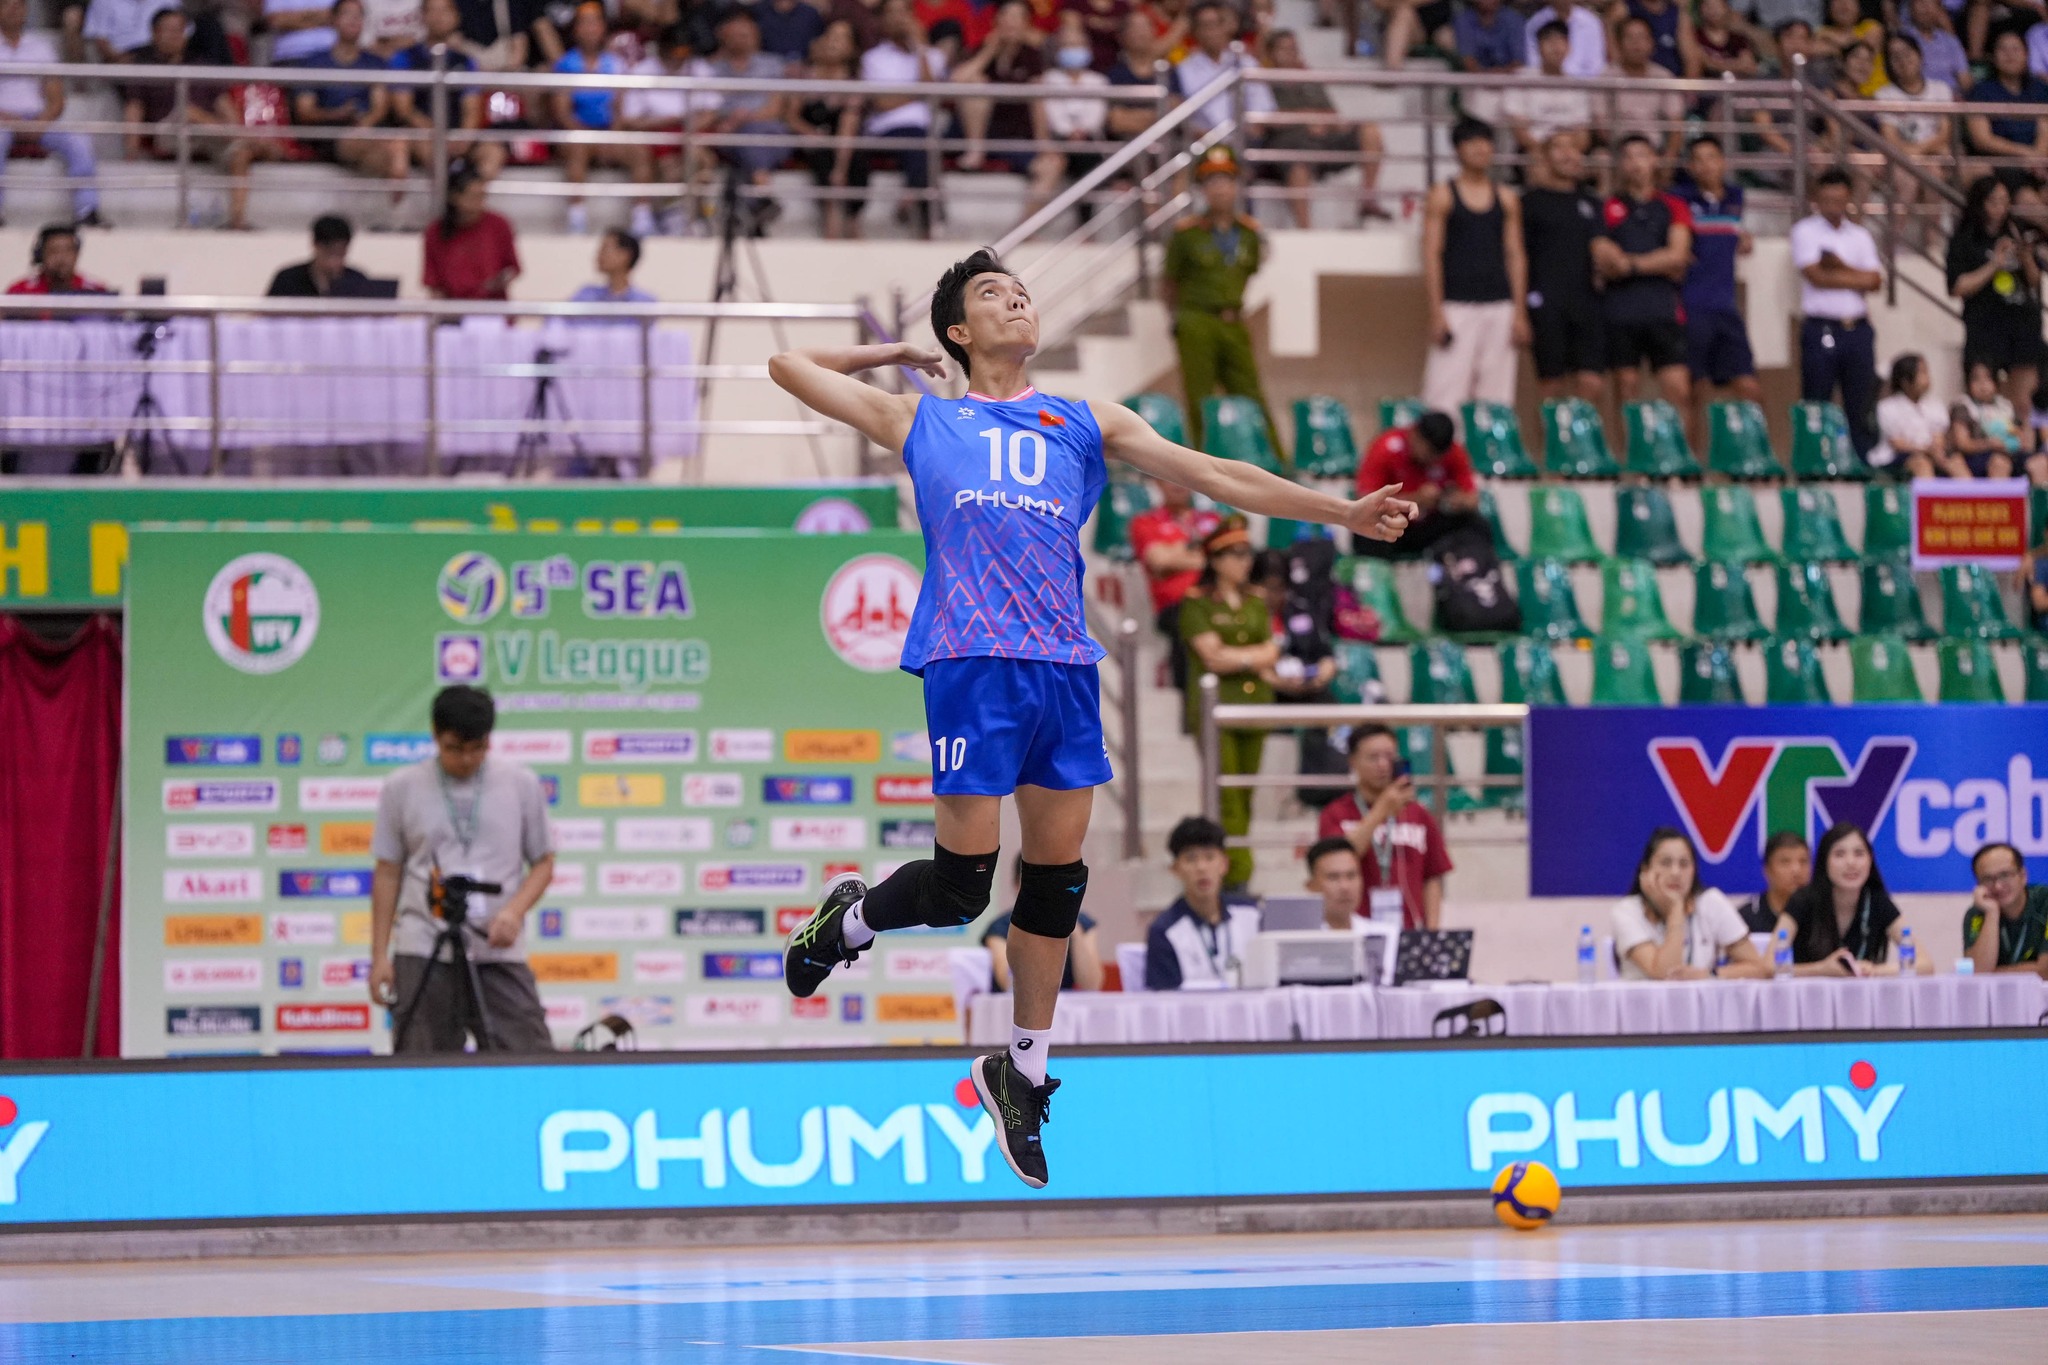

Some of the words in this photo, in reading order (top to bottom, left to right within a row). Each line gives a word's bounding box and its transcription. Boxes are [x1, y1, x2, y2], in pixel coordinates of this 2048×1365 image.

[980, 427, 1047, 486] 10
[955, 489, 1065, 519] PHUMY
[584, 563, 693, 616] SEA
[496, 634, 530, 682] V
[540, 633, 709, 689] League
[935, 737, 967, 772] 10
[178, 874, 249, 896] Akari
[539, 1103, 996, 1192] PHUMY
[1467, 1084, 1905, 1171] PHUMY
